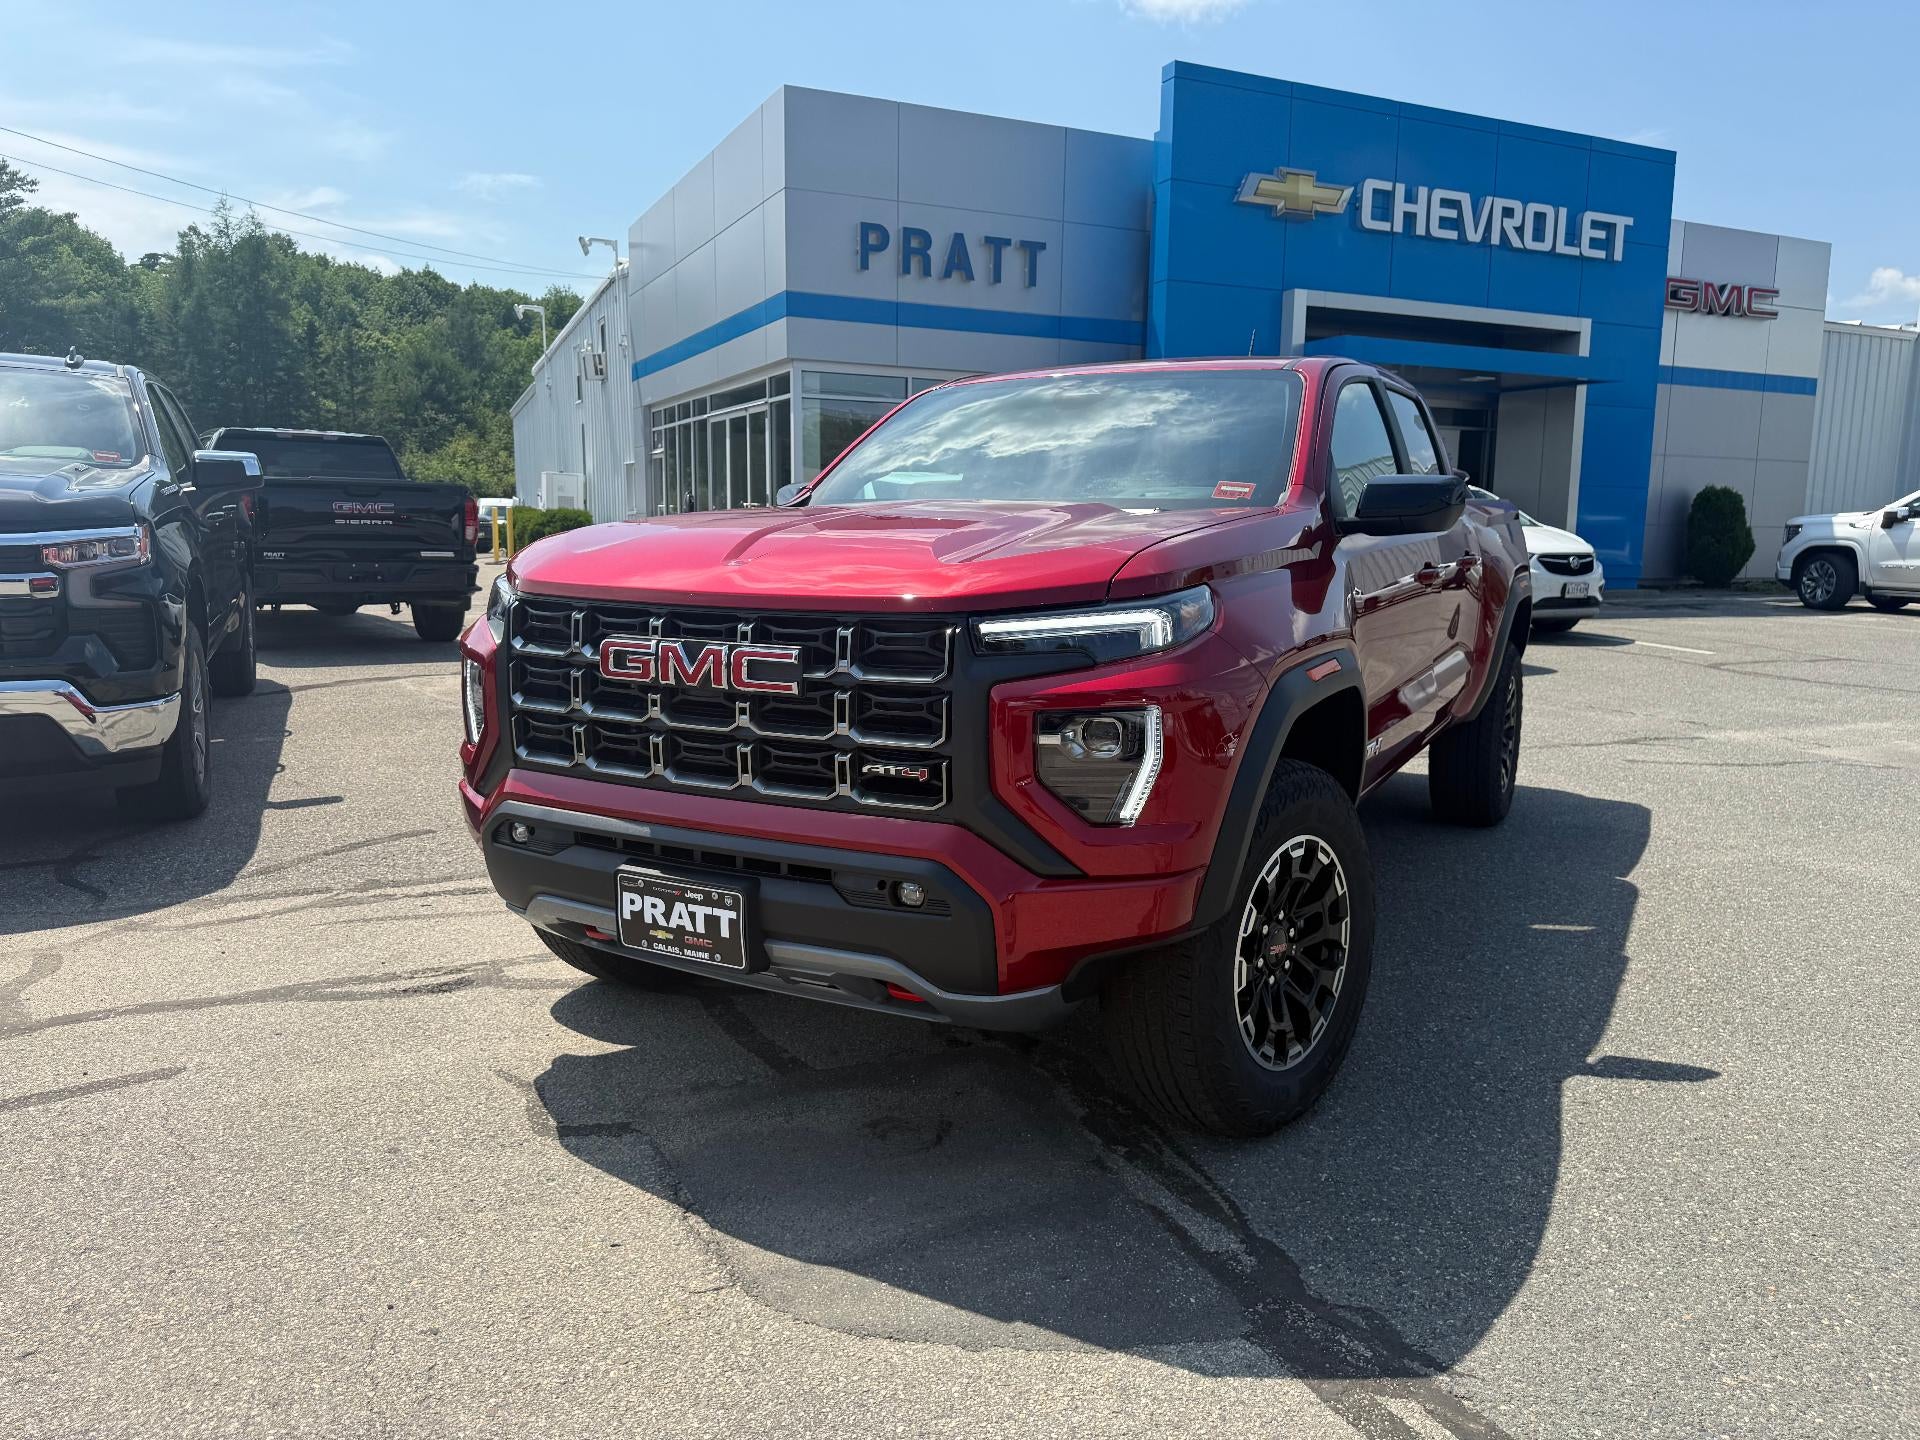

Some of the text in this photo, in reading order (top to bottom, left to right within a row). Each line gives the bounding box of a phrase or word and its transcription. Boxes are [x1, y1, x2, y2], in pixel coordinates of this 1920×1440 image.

[1360, 178, 1634, 262] CHEVROLET
[857, 221, 1047, 288] PRATT
[1665, 277, 1780, 319] GMC
[332, 501, 395, 514] GMC
[600, 637, 799, 695] GMC
[862, 764, 928, 781] AT4
[684, 889, 704, 902] Jeep
[622, 891, 737, 939] PRATT
[653, 942, 710, 960] CALAIS, MAINE
[684, 935, 713, 948] GMC
